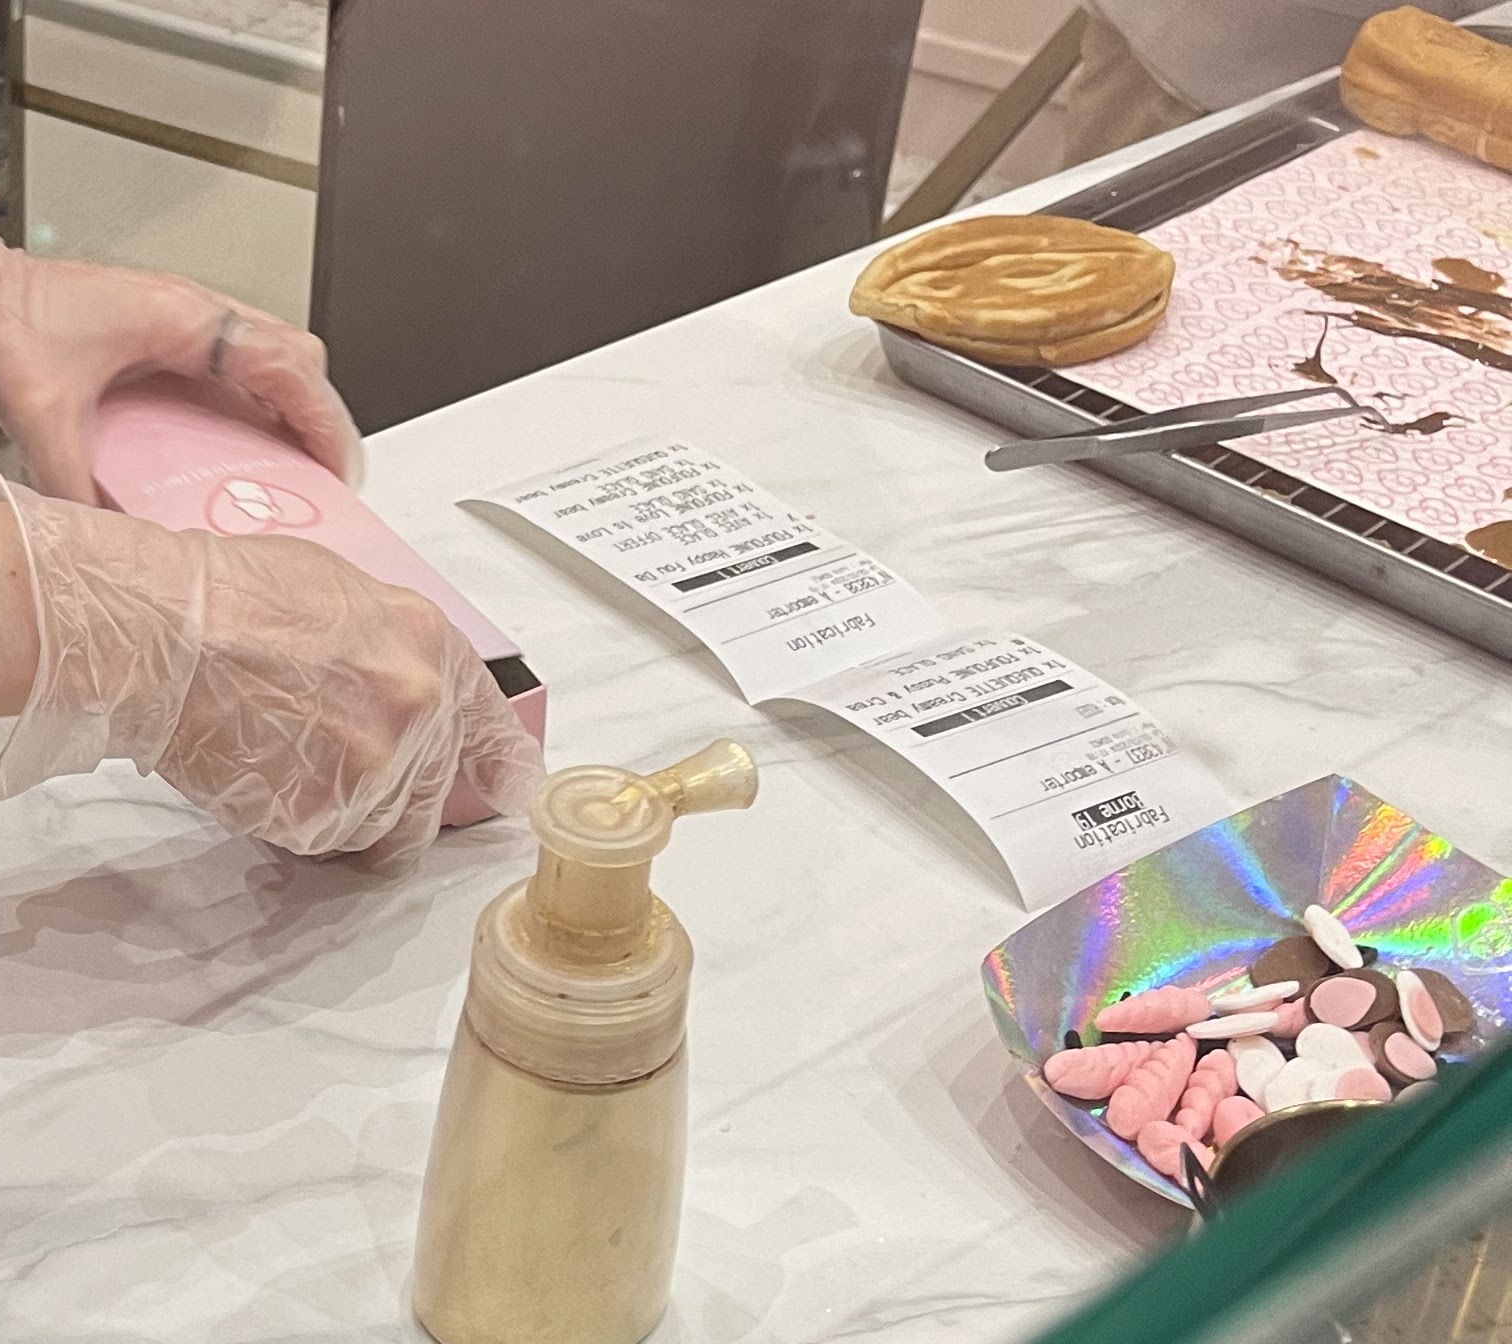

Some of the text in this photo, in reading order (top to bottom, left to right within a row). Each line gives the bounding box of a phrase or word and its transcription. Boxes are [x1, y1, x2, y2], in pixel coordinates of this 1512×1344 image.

[786, 613, 876, 652] Fabrication
[1073, 805, 1170, 849] Fabrication
[1075, 791, 1145, 832] Borne 19
